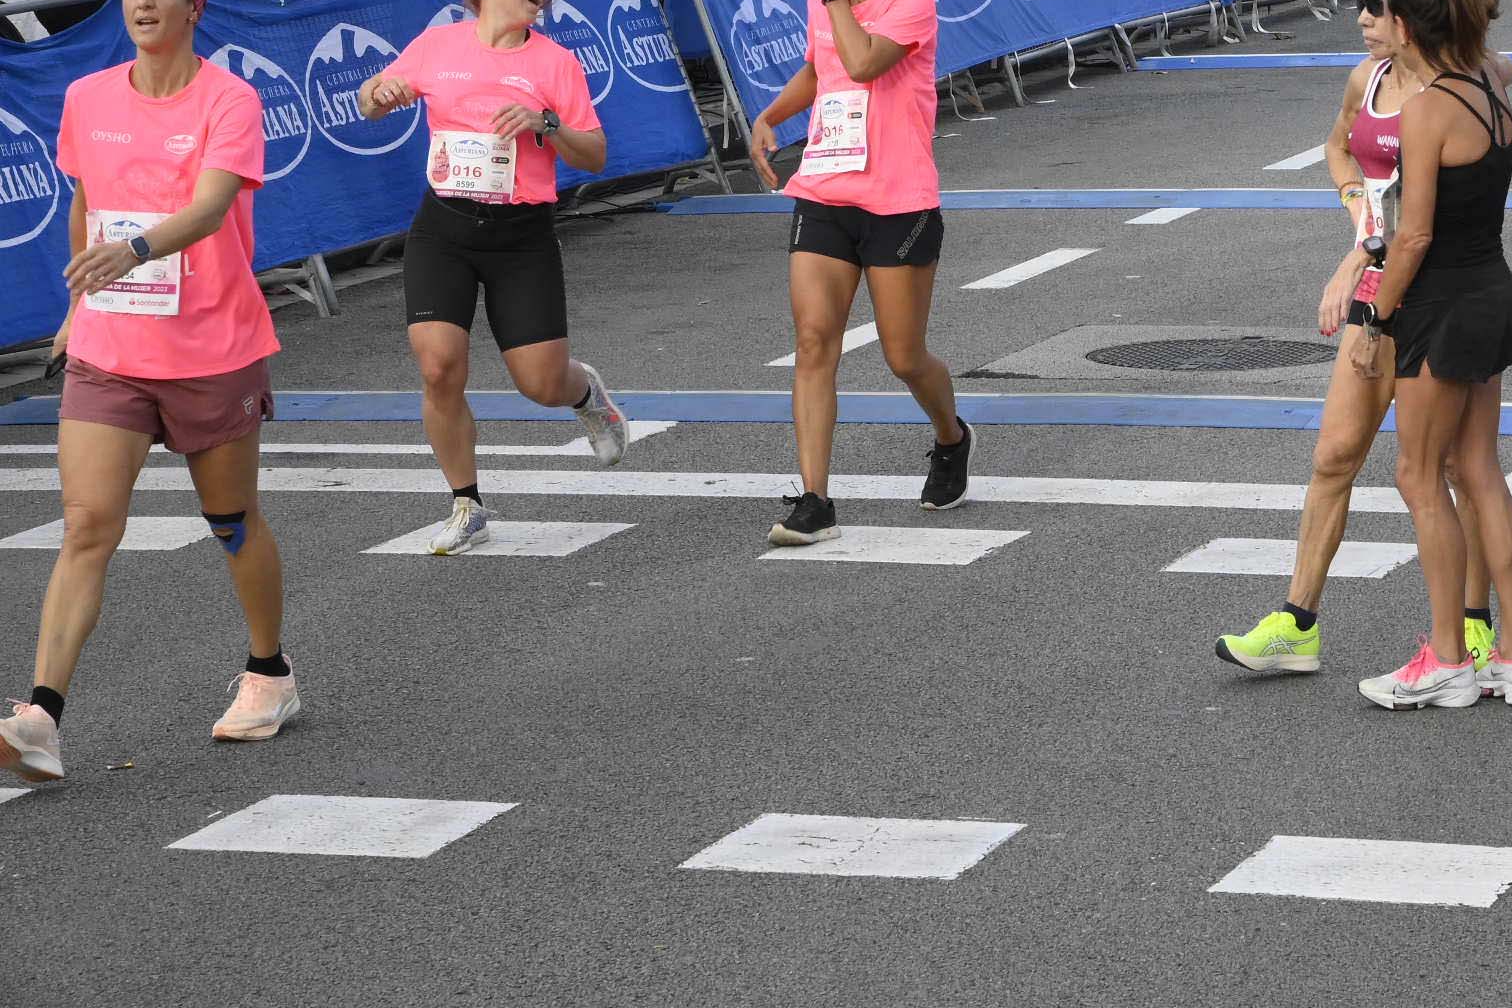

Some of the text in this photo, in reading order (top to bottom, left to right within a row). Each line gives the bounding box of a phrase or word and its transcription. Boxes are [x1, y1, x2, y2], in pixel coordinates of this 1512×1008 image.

[627, 16, 661, 32] CENTRAL
[326, 67, 363, 86] CENTRAL
[91, 130, 132, 144] OYSHO
[452, 165, 483, 178] 016
[455, 181, 475, 189] 8599
